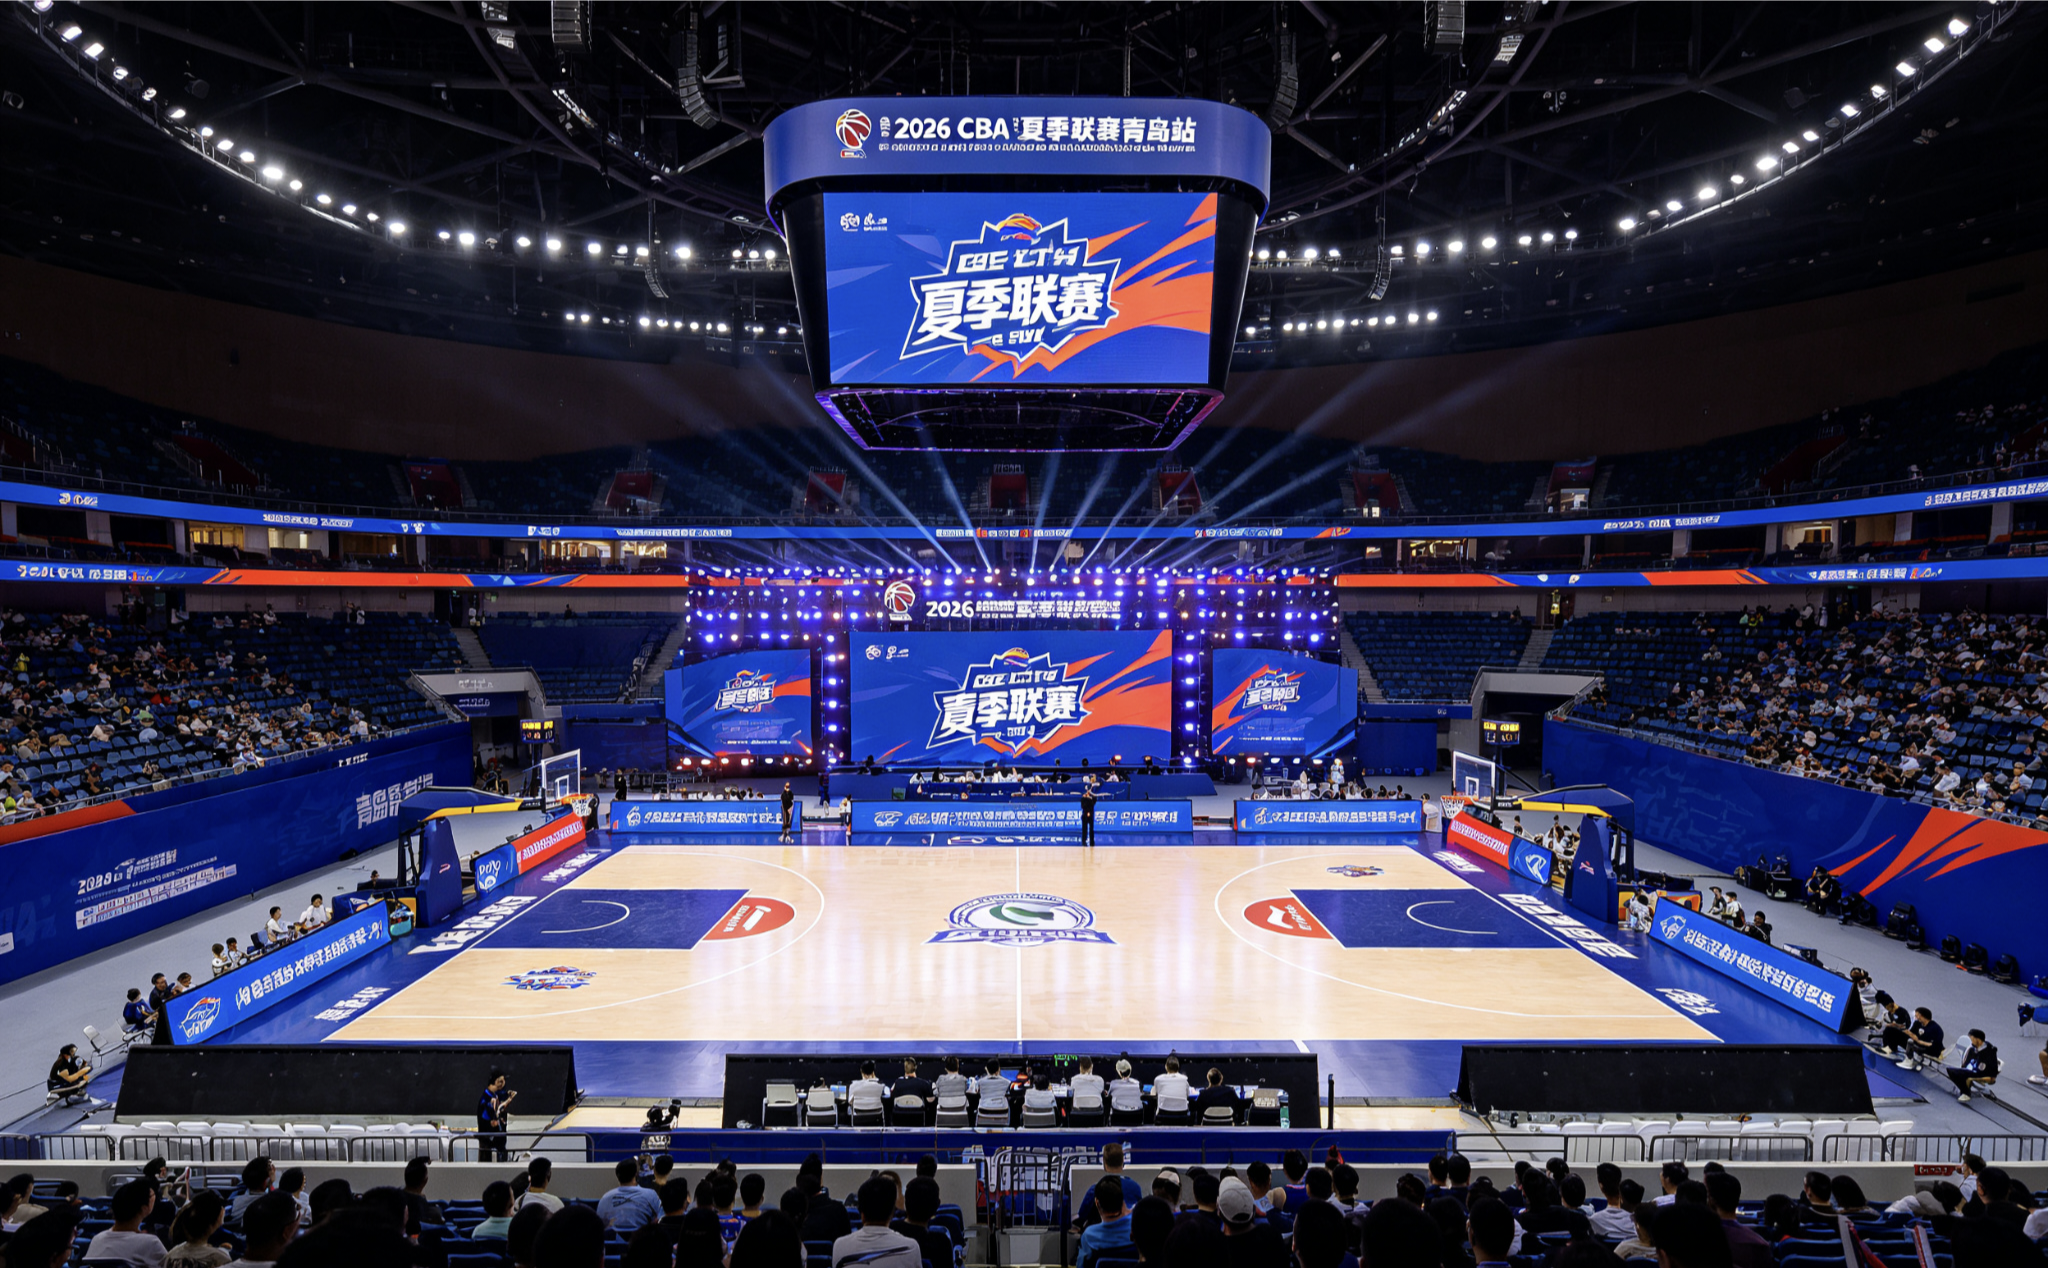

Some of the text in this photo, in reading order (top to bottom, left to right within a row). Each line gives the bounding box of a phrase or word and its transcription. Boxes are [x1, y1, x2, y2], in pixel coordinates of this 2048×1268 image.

[894, 117, 951, 140] 2026
[957, 117, 1010, 140] CBA
[912, 272, 1107, 346] 夏季联赛
[926, 600, 974, 618] 2026
